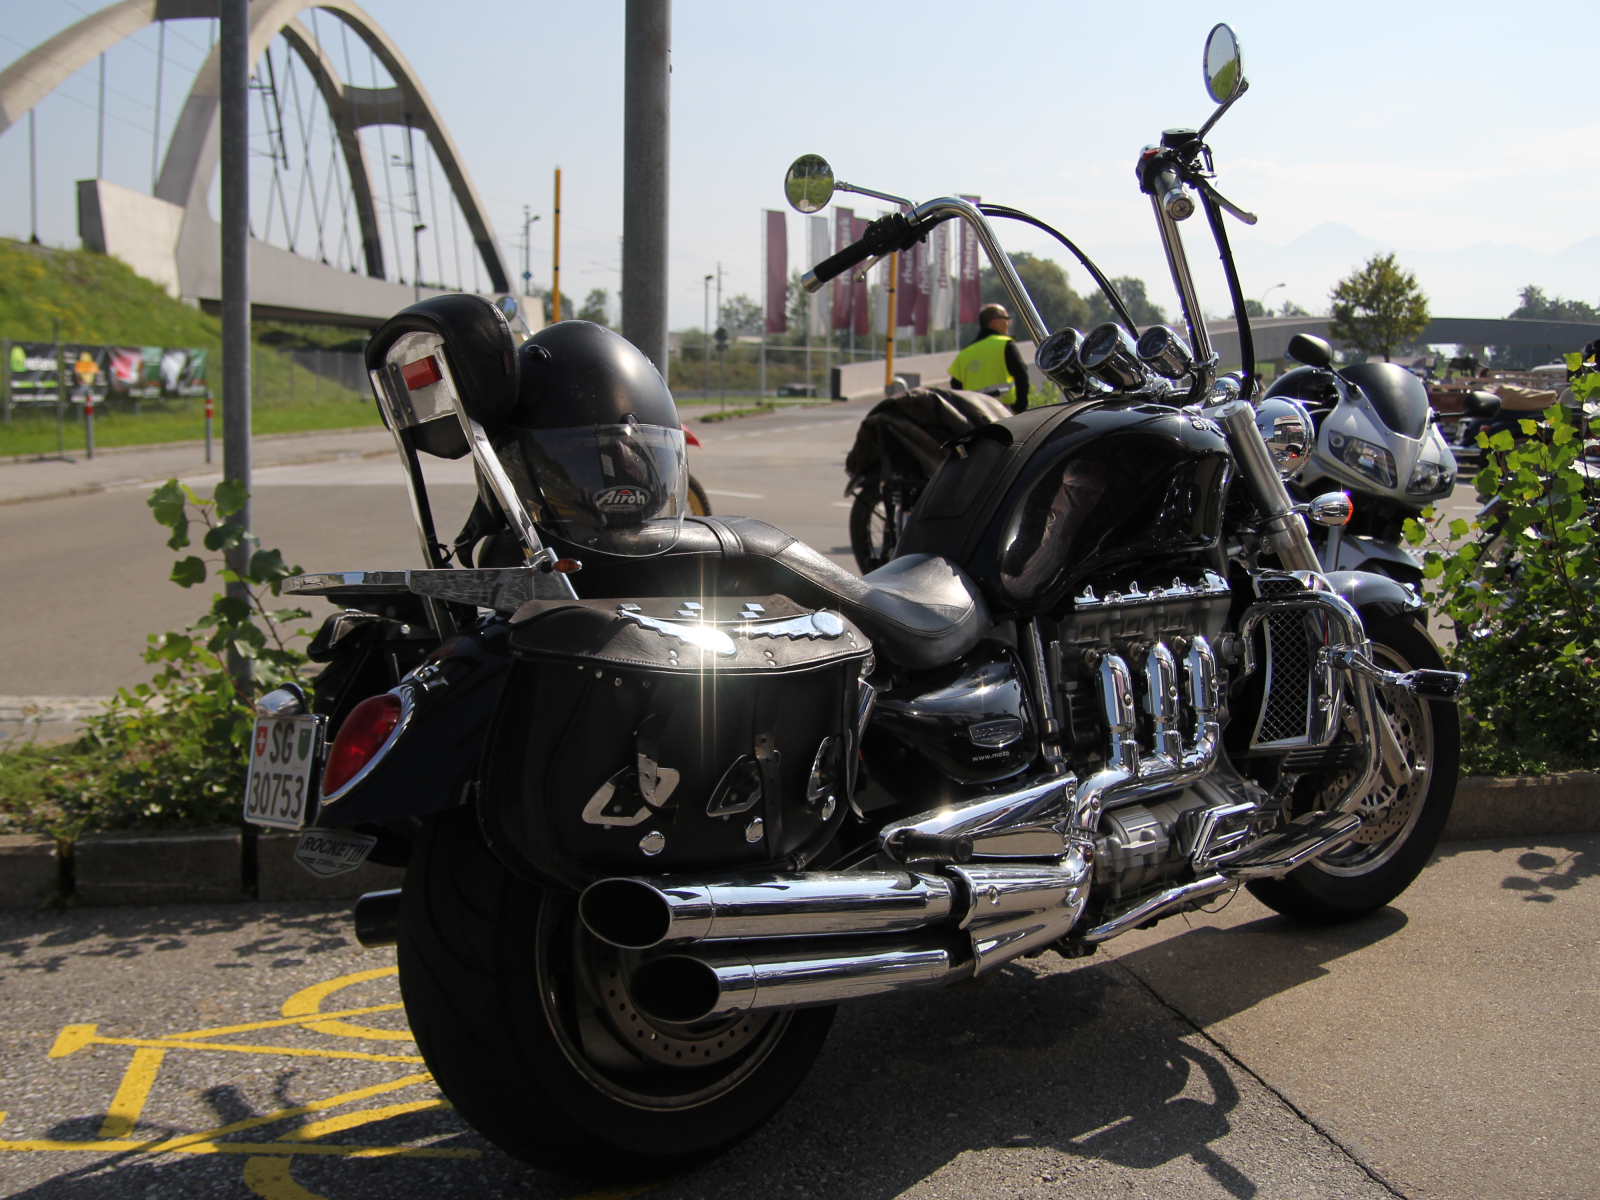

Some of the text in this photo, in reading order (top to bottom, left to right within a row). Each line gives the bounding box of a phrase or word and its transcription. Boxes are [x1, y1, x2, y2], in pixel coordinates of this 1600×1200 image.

[596, 490, 646, 505] Airoh
[269, 721, 295, 765] SG
[250, 771, 304, 819] 30753
[301, 836, 355, 857] ROCKET
